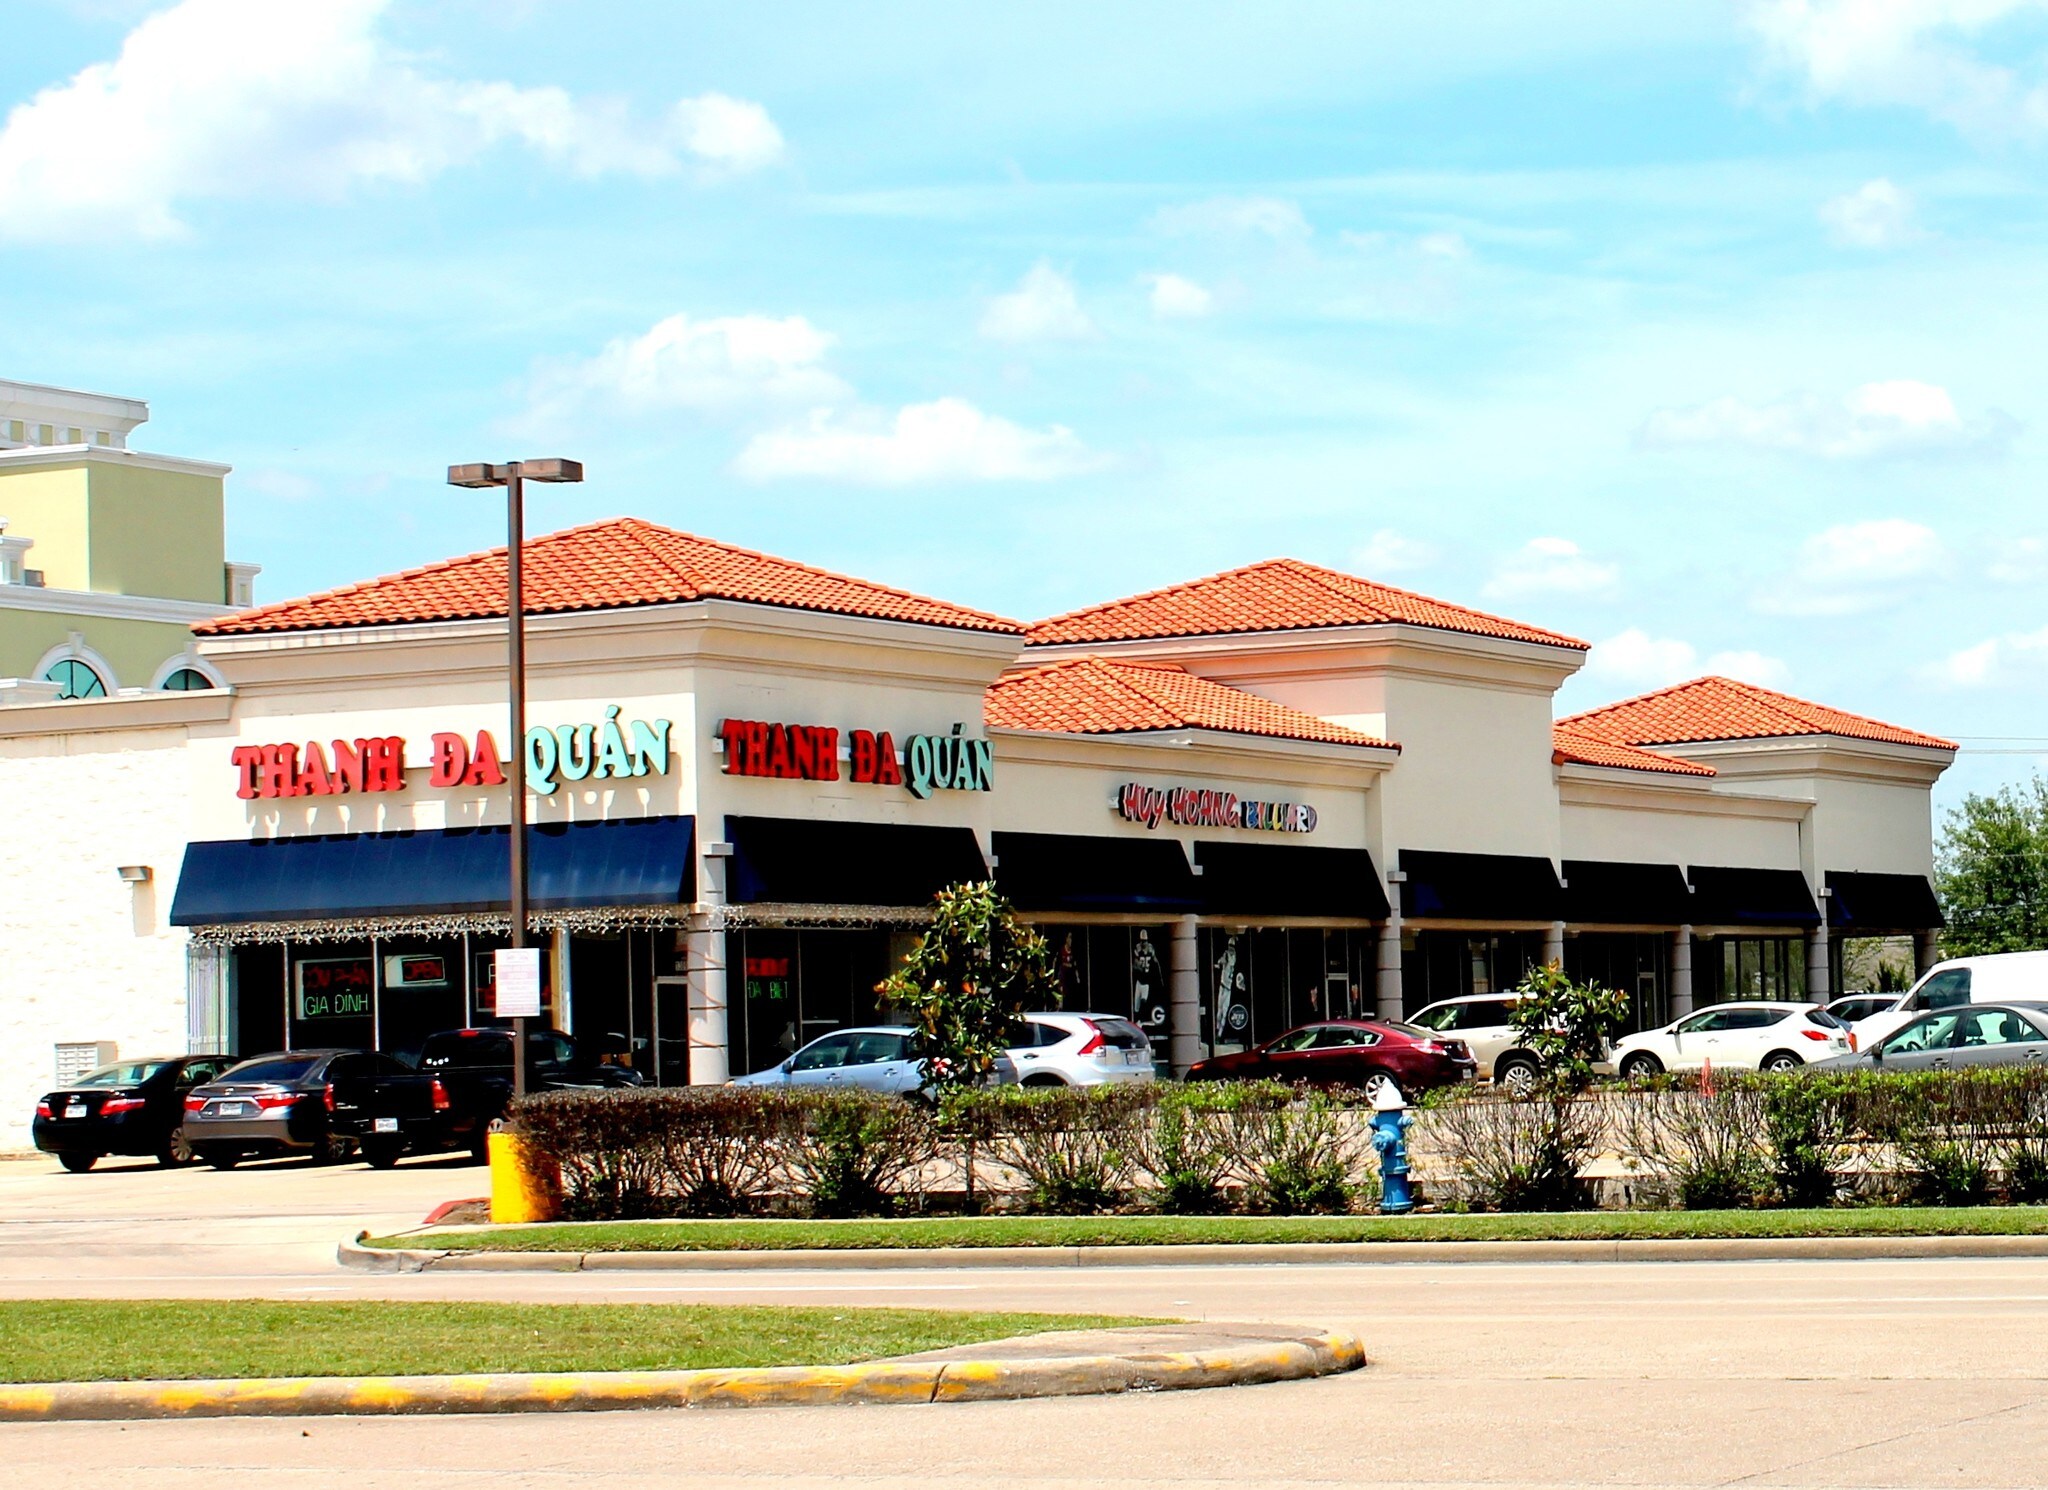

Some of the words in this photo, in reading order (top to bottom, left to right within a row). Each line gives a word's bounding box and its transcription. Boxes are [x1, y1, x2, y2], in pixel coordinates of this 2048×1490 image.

[232, 737, 405, 799] THANH
[430, 730, 507, 787] ĐA
[525, 705, 673, 795] QUÁN
[718, 718, 840, 782] THANH
[848, 729, 902, 785] ĐA
[904, 722, 994, 800] QUÁN
[1119, 783, 1165, 829] HUY
[1167, 786, 1239, 828] HOANG
[1151, 1006, 1165, 1024] G
